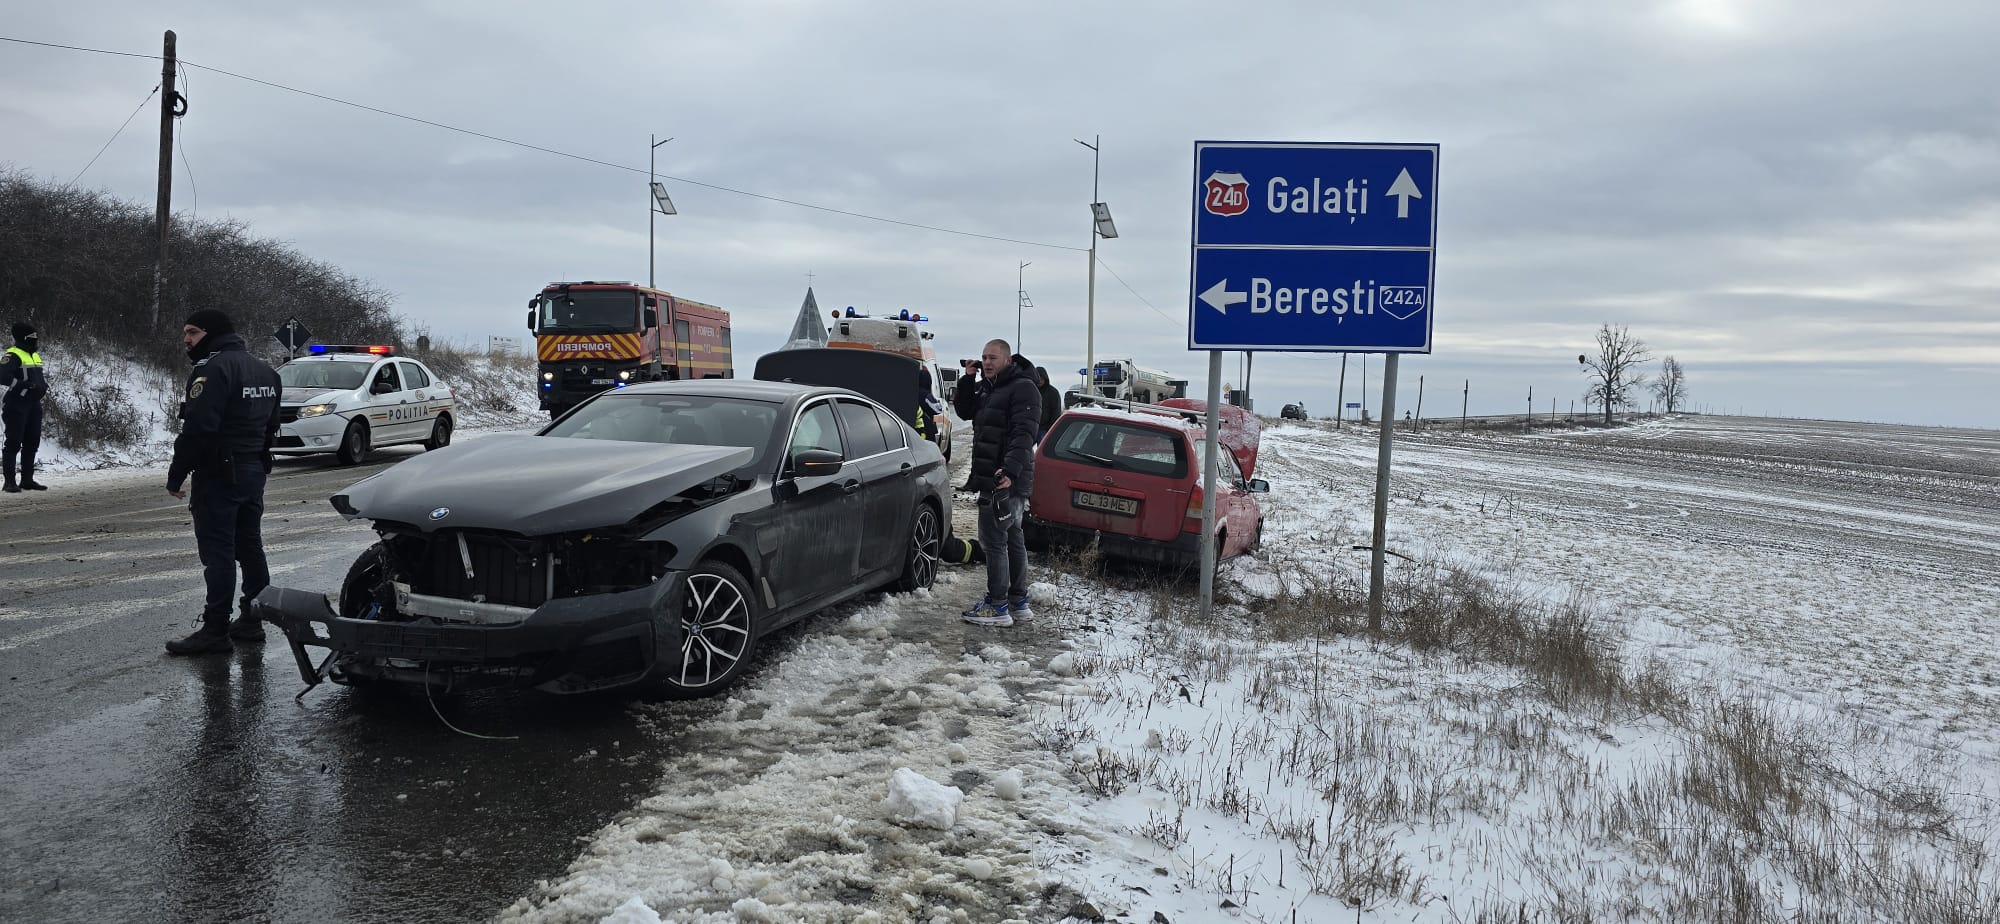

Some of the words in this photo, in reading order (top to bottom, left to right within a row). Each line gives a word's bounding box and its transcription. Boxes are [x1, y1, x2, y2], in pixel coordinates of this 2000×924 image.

[1211, 186, 1243, 207] 24D
[1266, 176, 1368, 225] Galați
[1250, 277, 1375, 325] Berești
[1383, 289, 1423, 306] 242A
[242, 386, 277, 399] POLITIA
[388, 405, 428, 421] POLITIA
[1080, 493, 1095, 506] GL
[1099, 497, 1109, 508] 13
[1110, 498, 1134, 513] MEY
